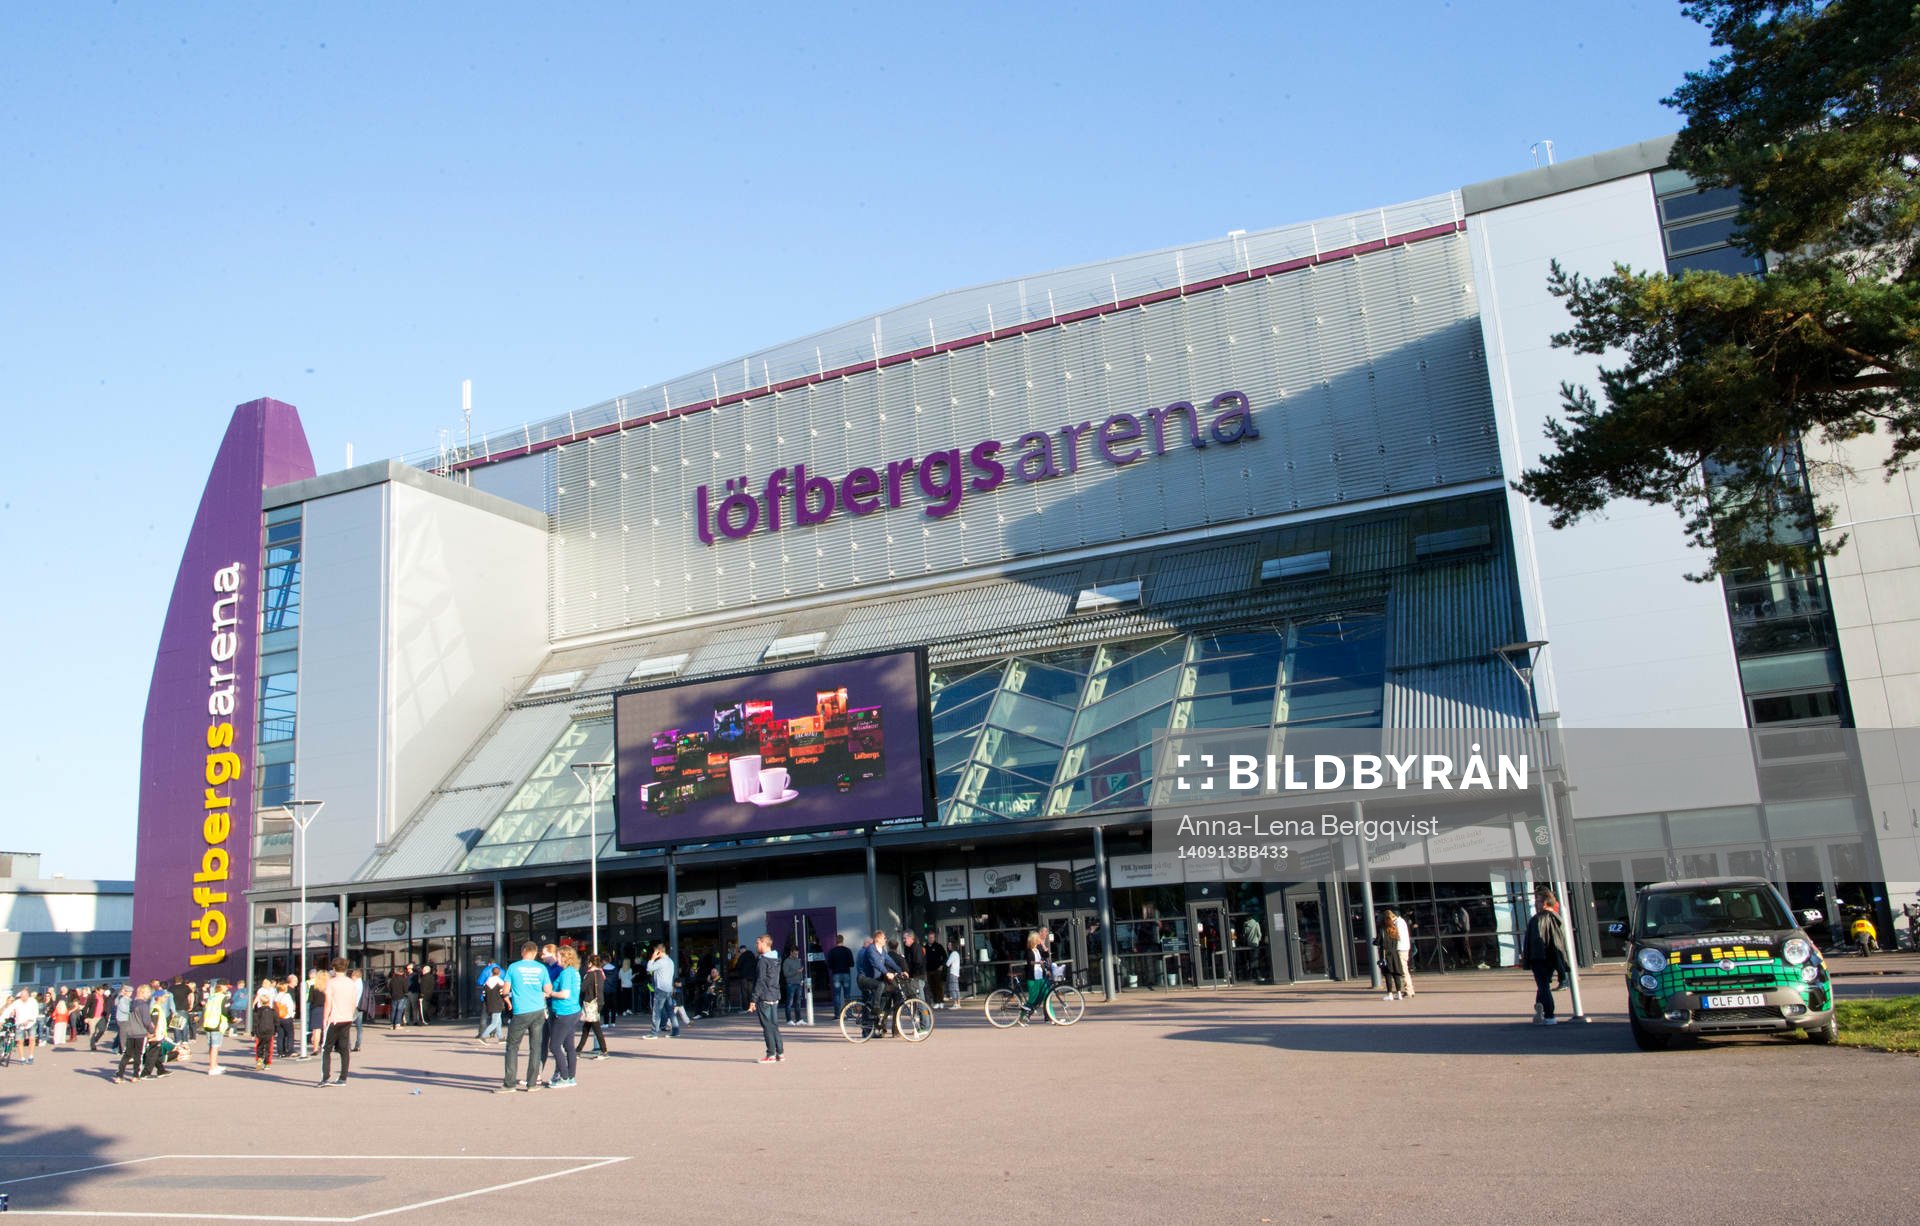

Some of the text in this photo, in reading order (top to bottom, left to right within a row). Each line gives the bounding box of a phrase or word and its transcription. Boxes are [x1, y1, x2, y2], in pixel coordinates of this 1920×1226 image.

[1696, 935, 1752, 945] RADIO
[1711, 995, 1760, 1007] CLF 010
